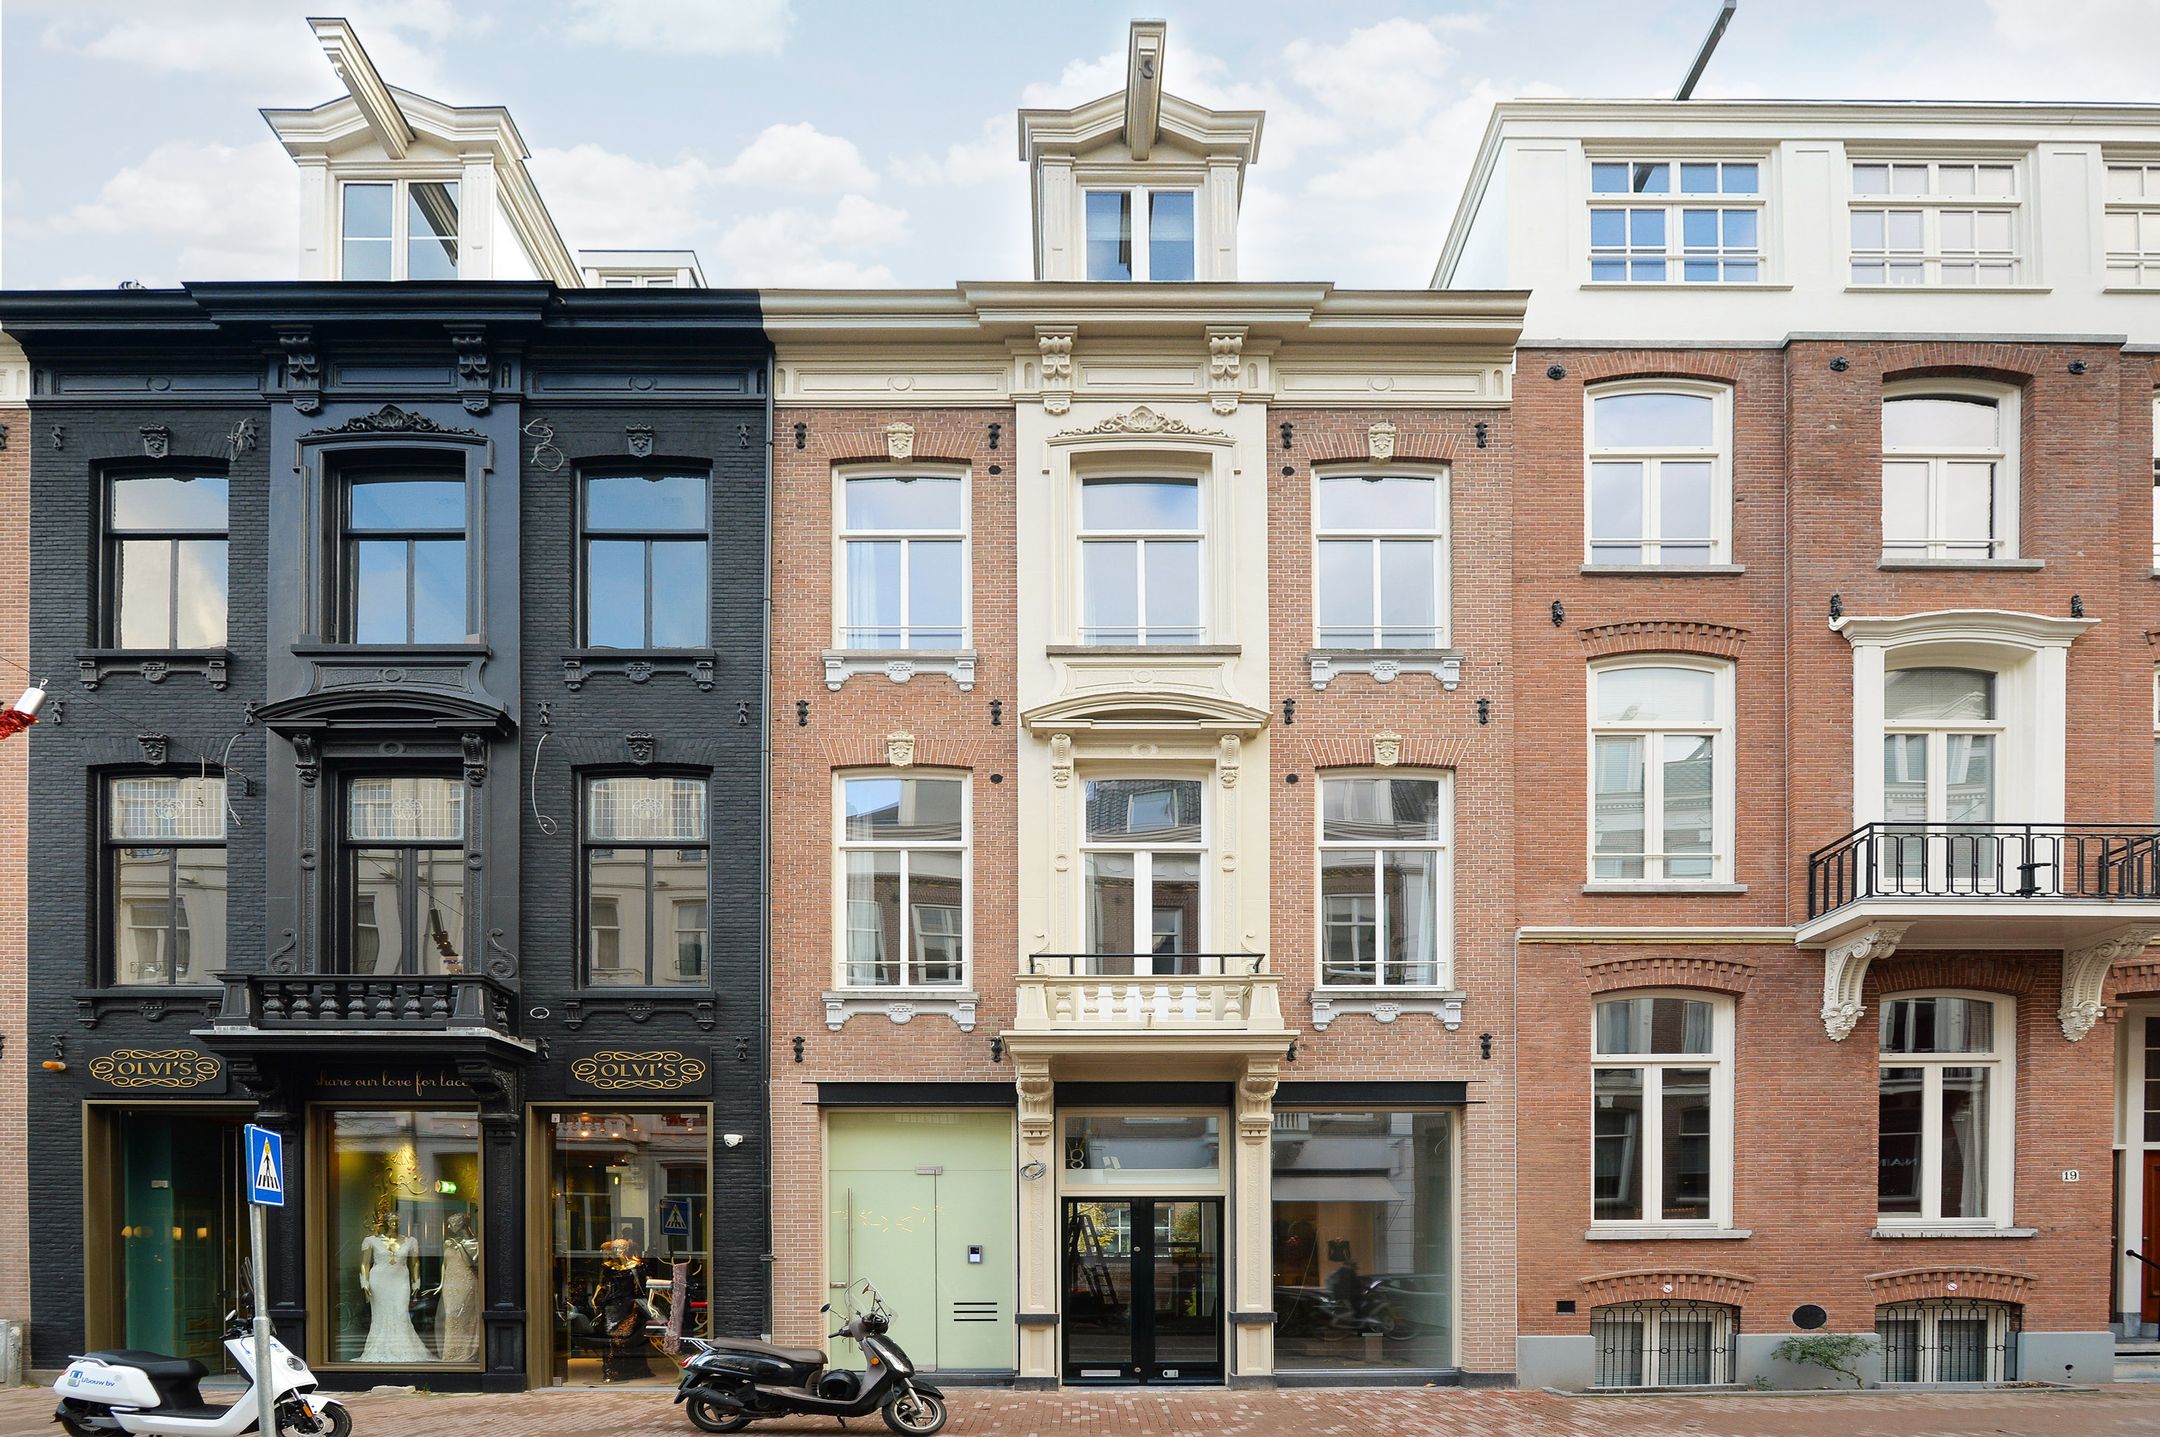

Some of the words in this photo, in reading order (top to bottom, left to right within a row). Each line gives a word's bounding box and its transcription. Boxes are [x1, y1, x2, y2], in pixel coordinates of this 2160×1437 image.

[117, 1061, 192, 1076] OLVI'S
[600, 1062, 676, 1077] OLVI'S
[315, 1071, 352, 1088] share
[355, 1079, 379, 1088] our
[382, 1071, 412, 1088] love
[415, 1071, 437, 1097] for
[2064, 1170, 2077, 1181] 19
